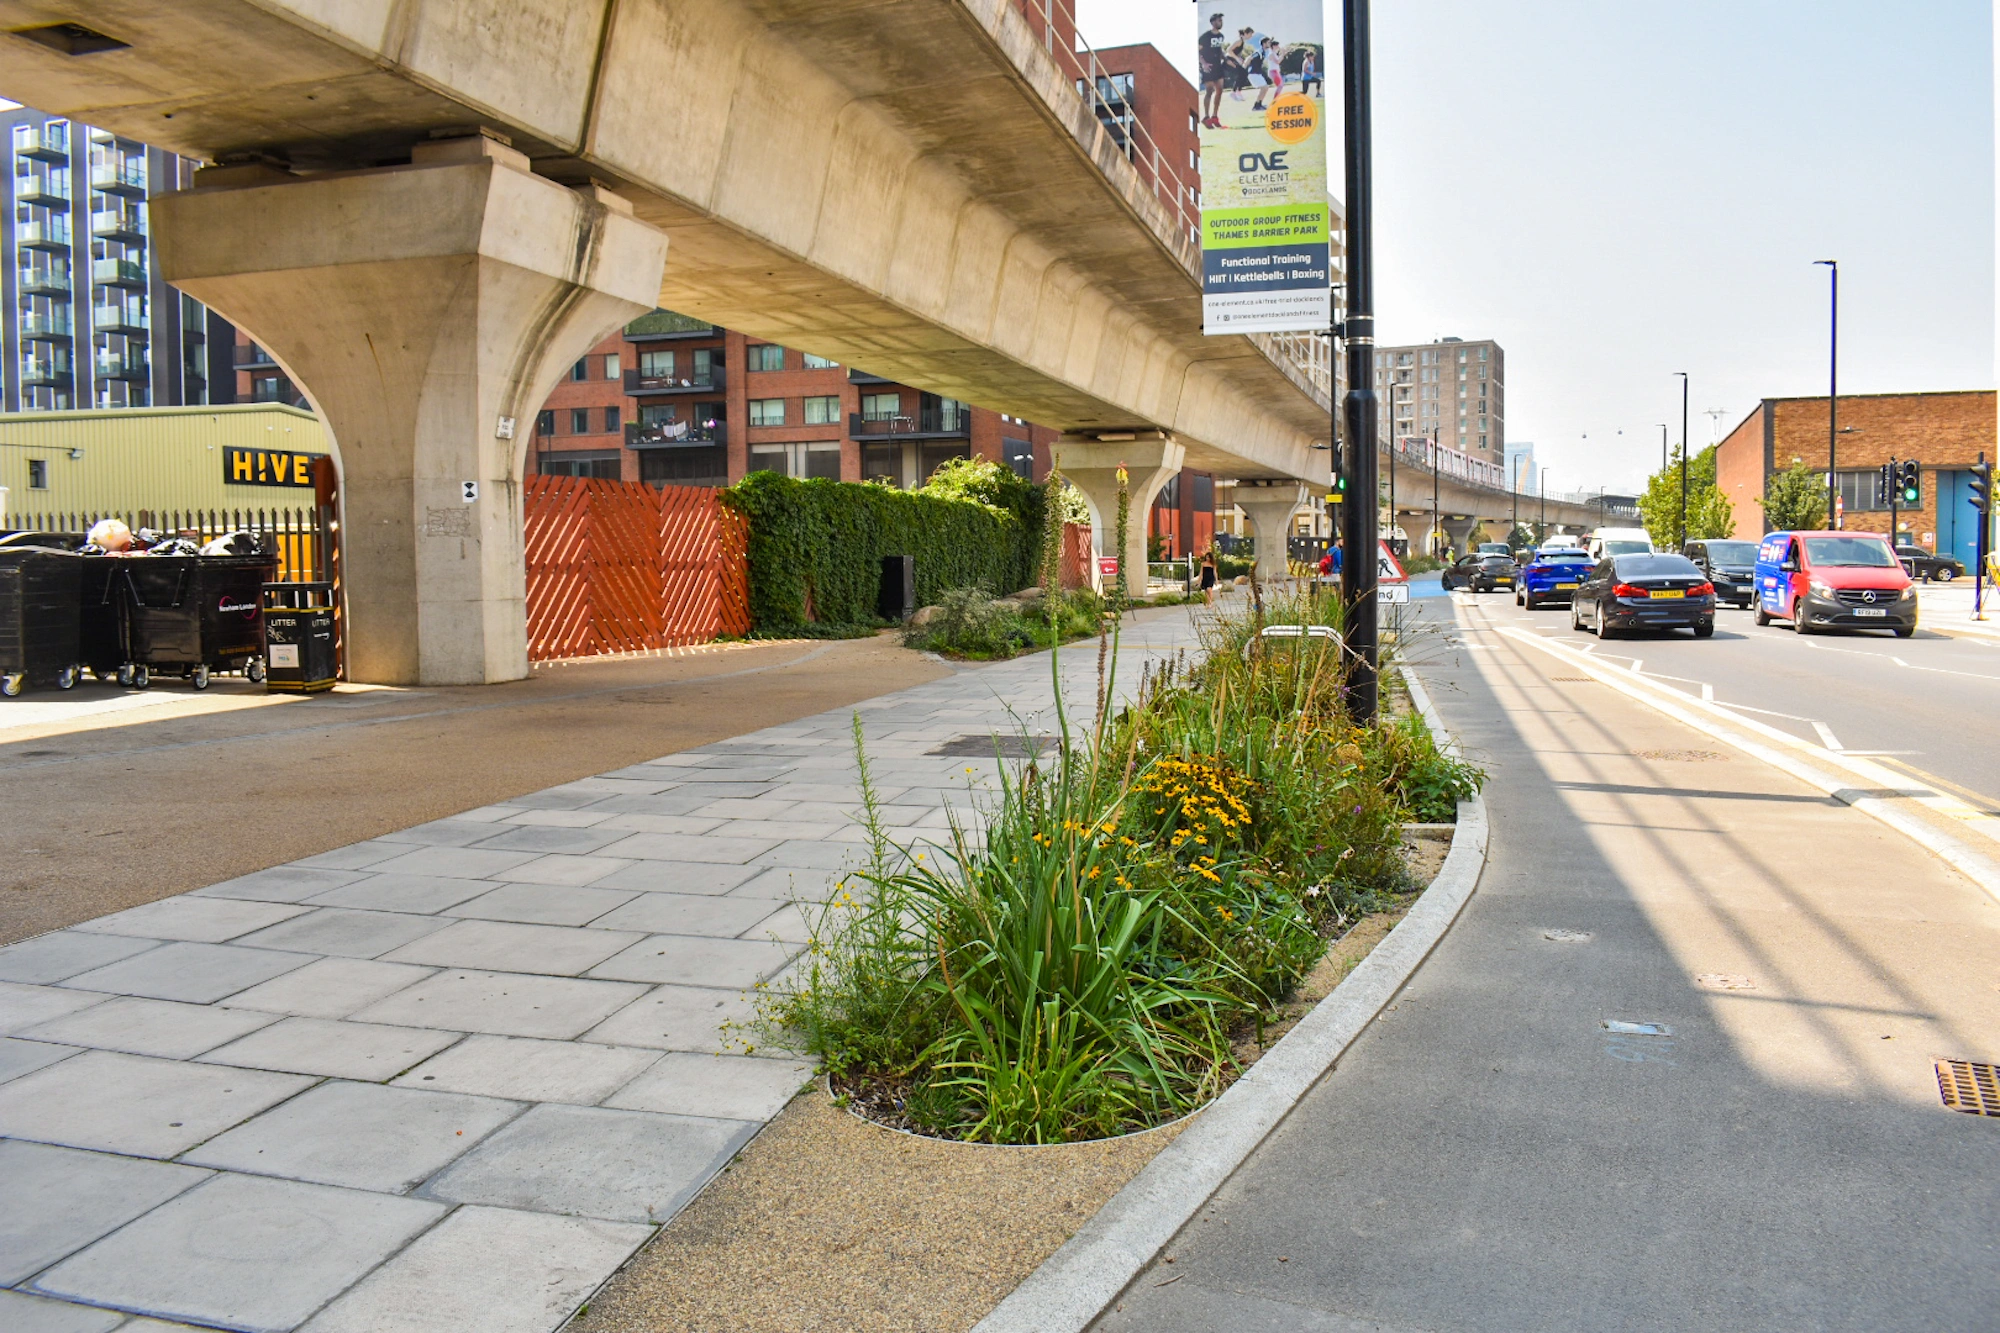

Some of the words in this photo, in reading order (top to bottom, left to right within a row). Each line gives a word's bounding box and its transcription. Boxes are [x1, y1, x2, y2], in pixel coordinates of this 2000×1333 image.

[1277, 104, 1304, 116] FREE
[1271, 118, 1312, 130] SESSION
[1239, 150, 1289, 172] ONE
[1239, 172, 1290, 184] ELEMENT
[1247, 186, 1287, 195] DOCKLANDS
[1209, 218, 1250, 228] OUTDOOR
[1252, 215, 1282, 226] GROUP
[1284, 213, 1321, 223] FITNESS
[1213, 230, 1249, 240] THAMES
[1252, 227, 1291, 238] BARRIER
[1293, 225, 1318, 235] PARK
[1221, 255, 1270, 268] Functional
[1272, 253, 1312, 265] Training
[1209, 273, 1227, 284] HIIT
[1233, 270, 1285, 283] Kettlebells
[1291, 268, 1325, 280] Boxing
[1378, 590, 1393, 599] nd
[270, 618, 297, 627] LITTER
[311, 617, 331, 628] LITTER
